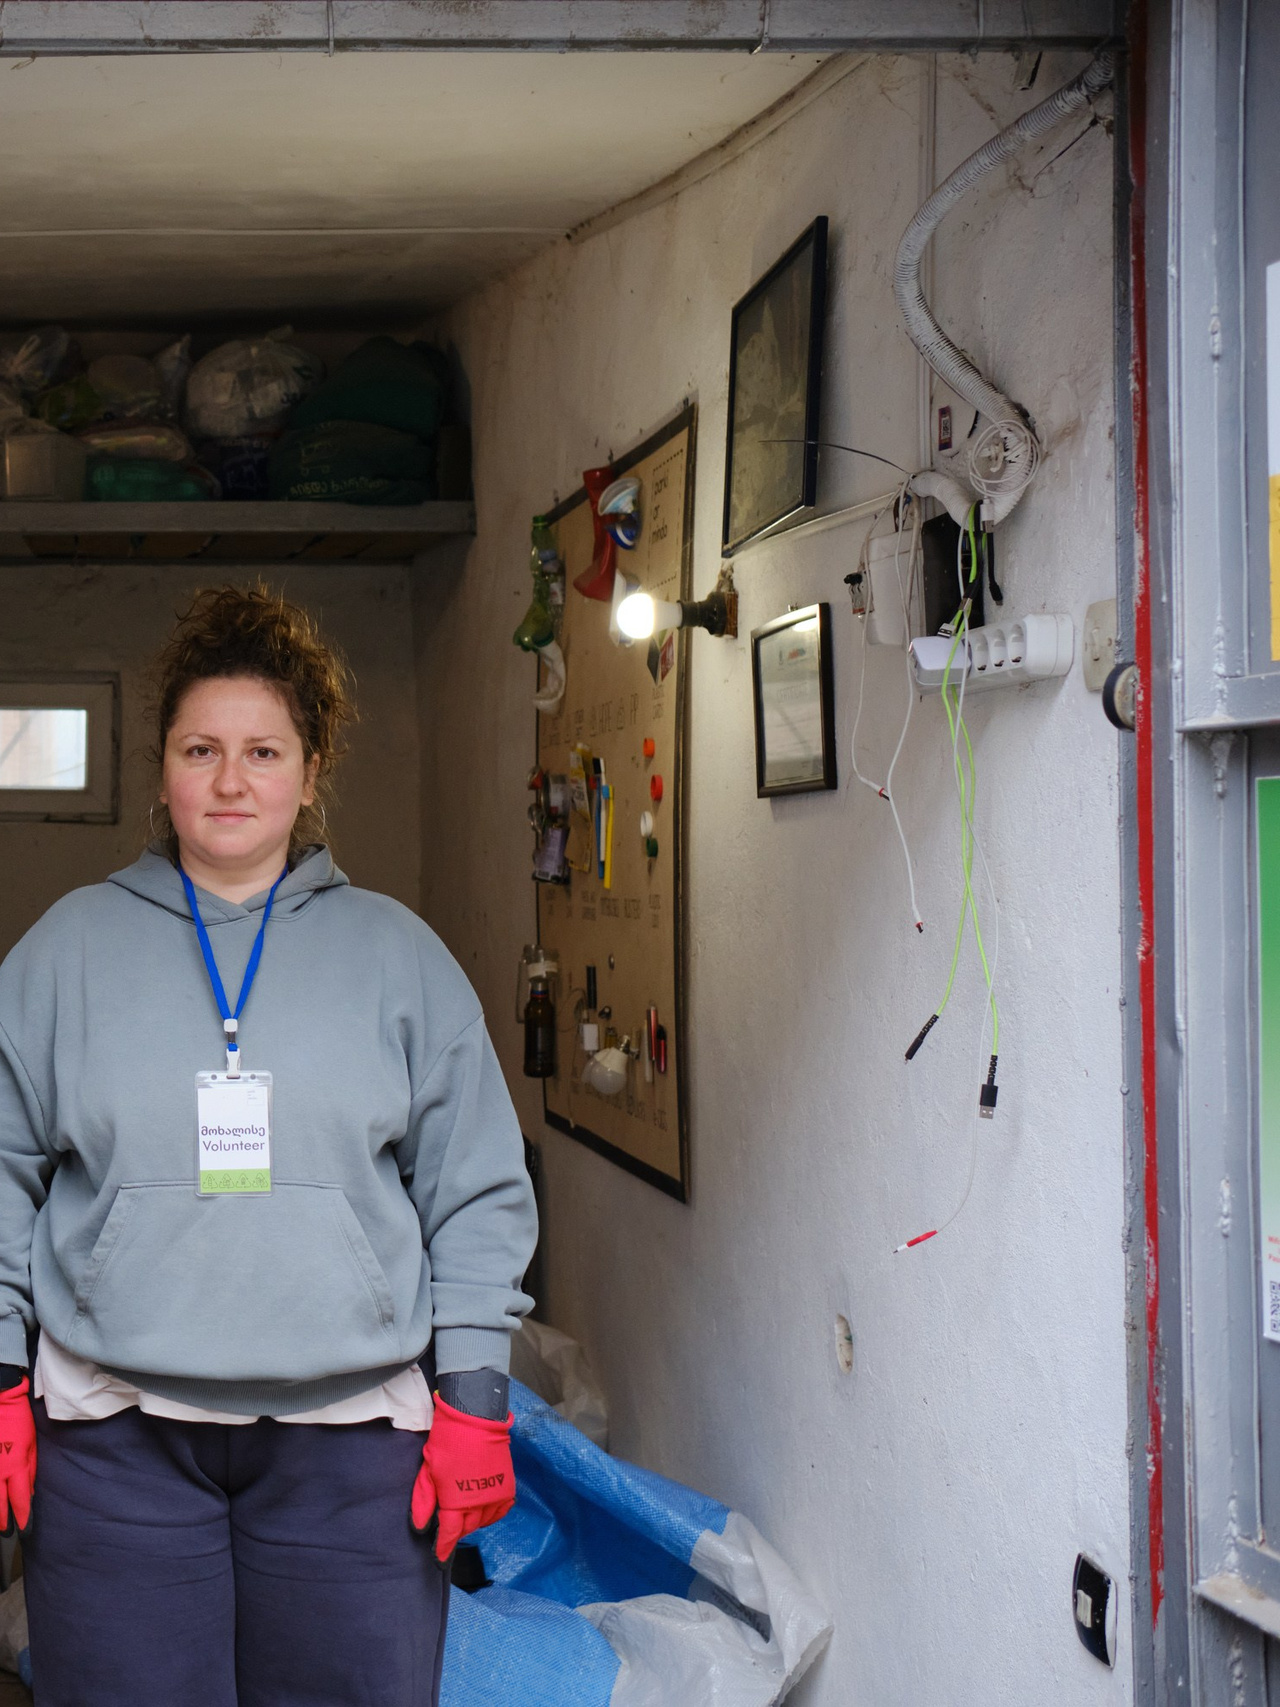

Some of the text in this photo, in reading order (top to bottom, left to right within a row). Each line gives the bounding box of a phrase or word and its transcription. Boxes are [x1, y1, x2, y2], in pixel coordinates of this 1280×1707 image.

[201, 1124, 266, 1138] მოხალისე
[202, 1140, 265, 1152] Volunteer
[455, 1476, 496, 1492] DELTA
